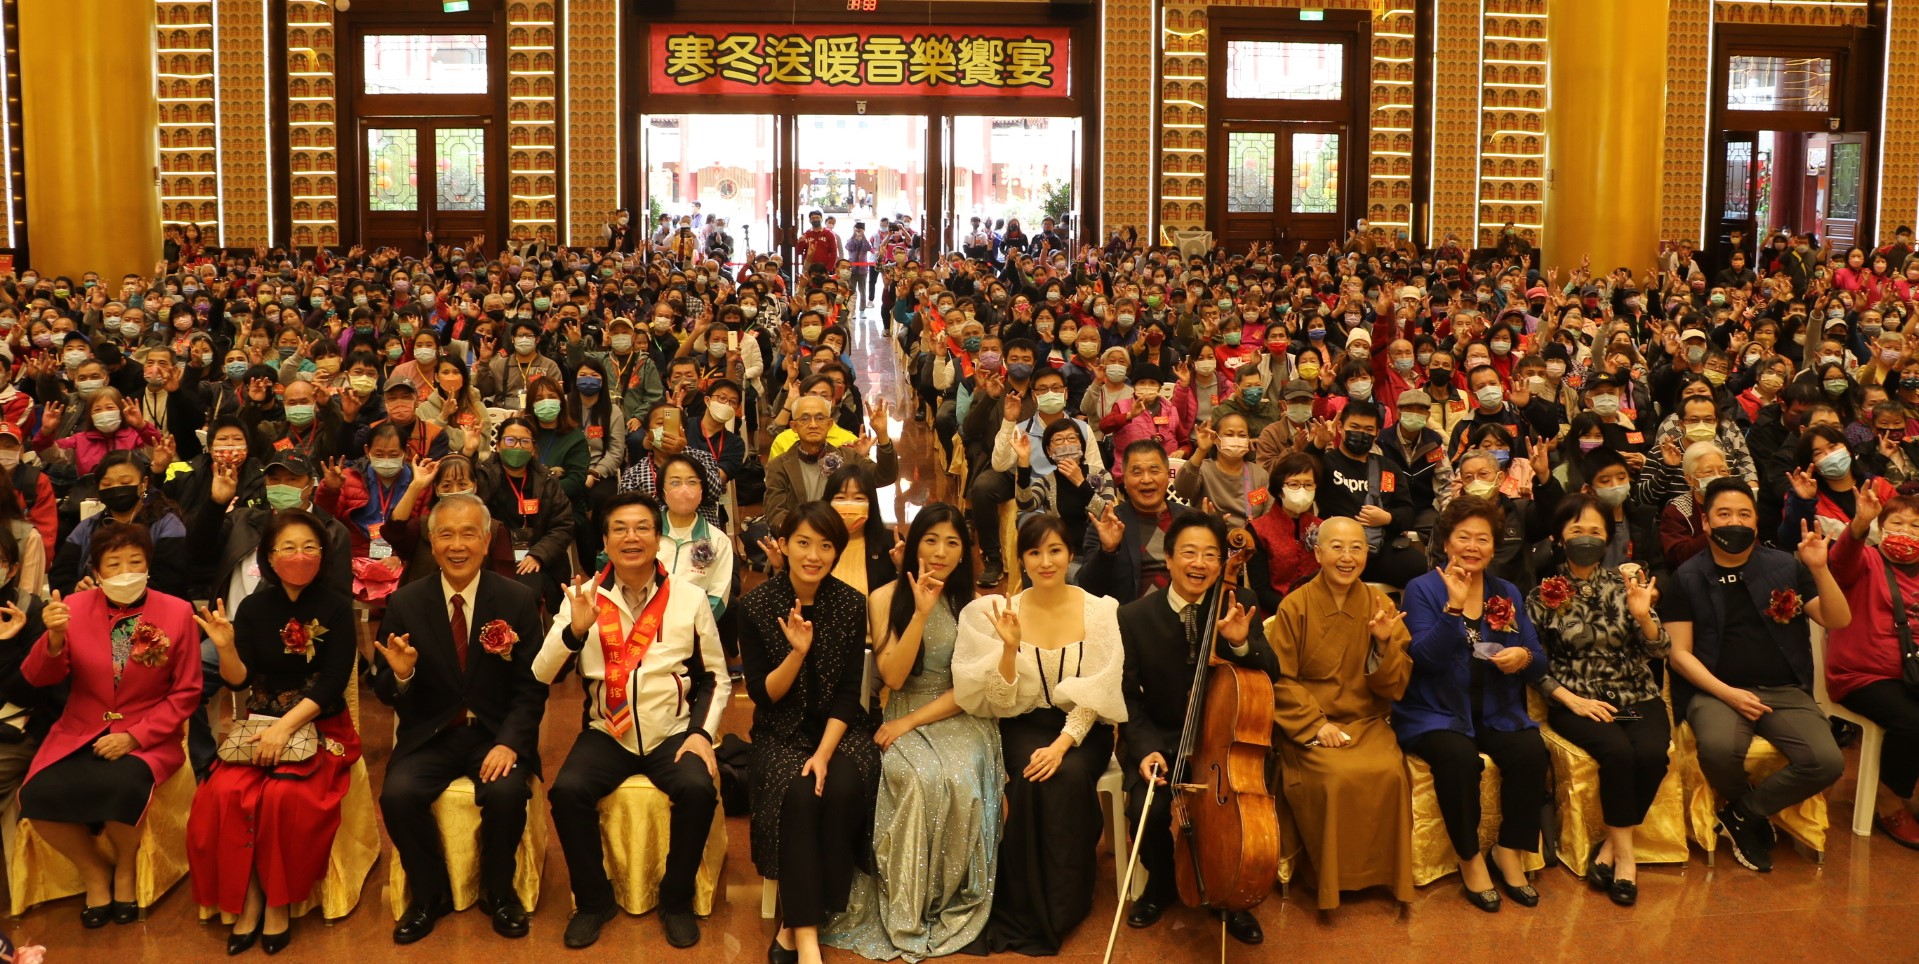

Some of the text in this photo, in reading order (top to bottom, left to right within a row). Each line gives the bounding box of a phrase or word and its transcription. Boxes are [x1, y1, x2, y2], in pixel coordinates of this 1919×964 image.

[666, 33, 1053, 87] 寒冬送暖音樂饗宴
[605, 634, 624, 699] 慈悲喜捨
